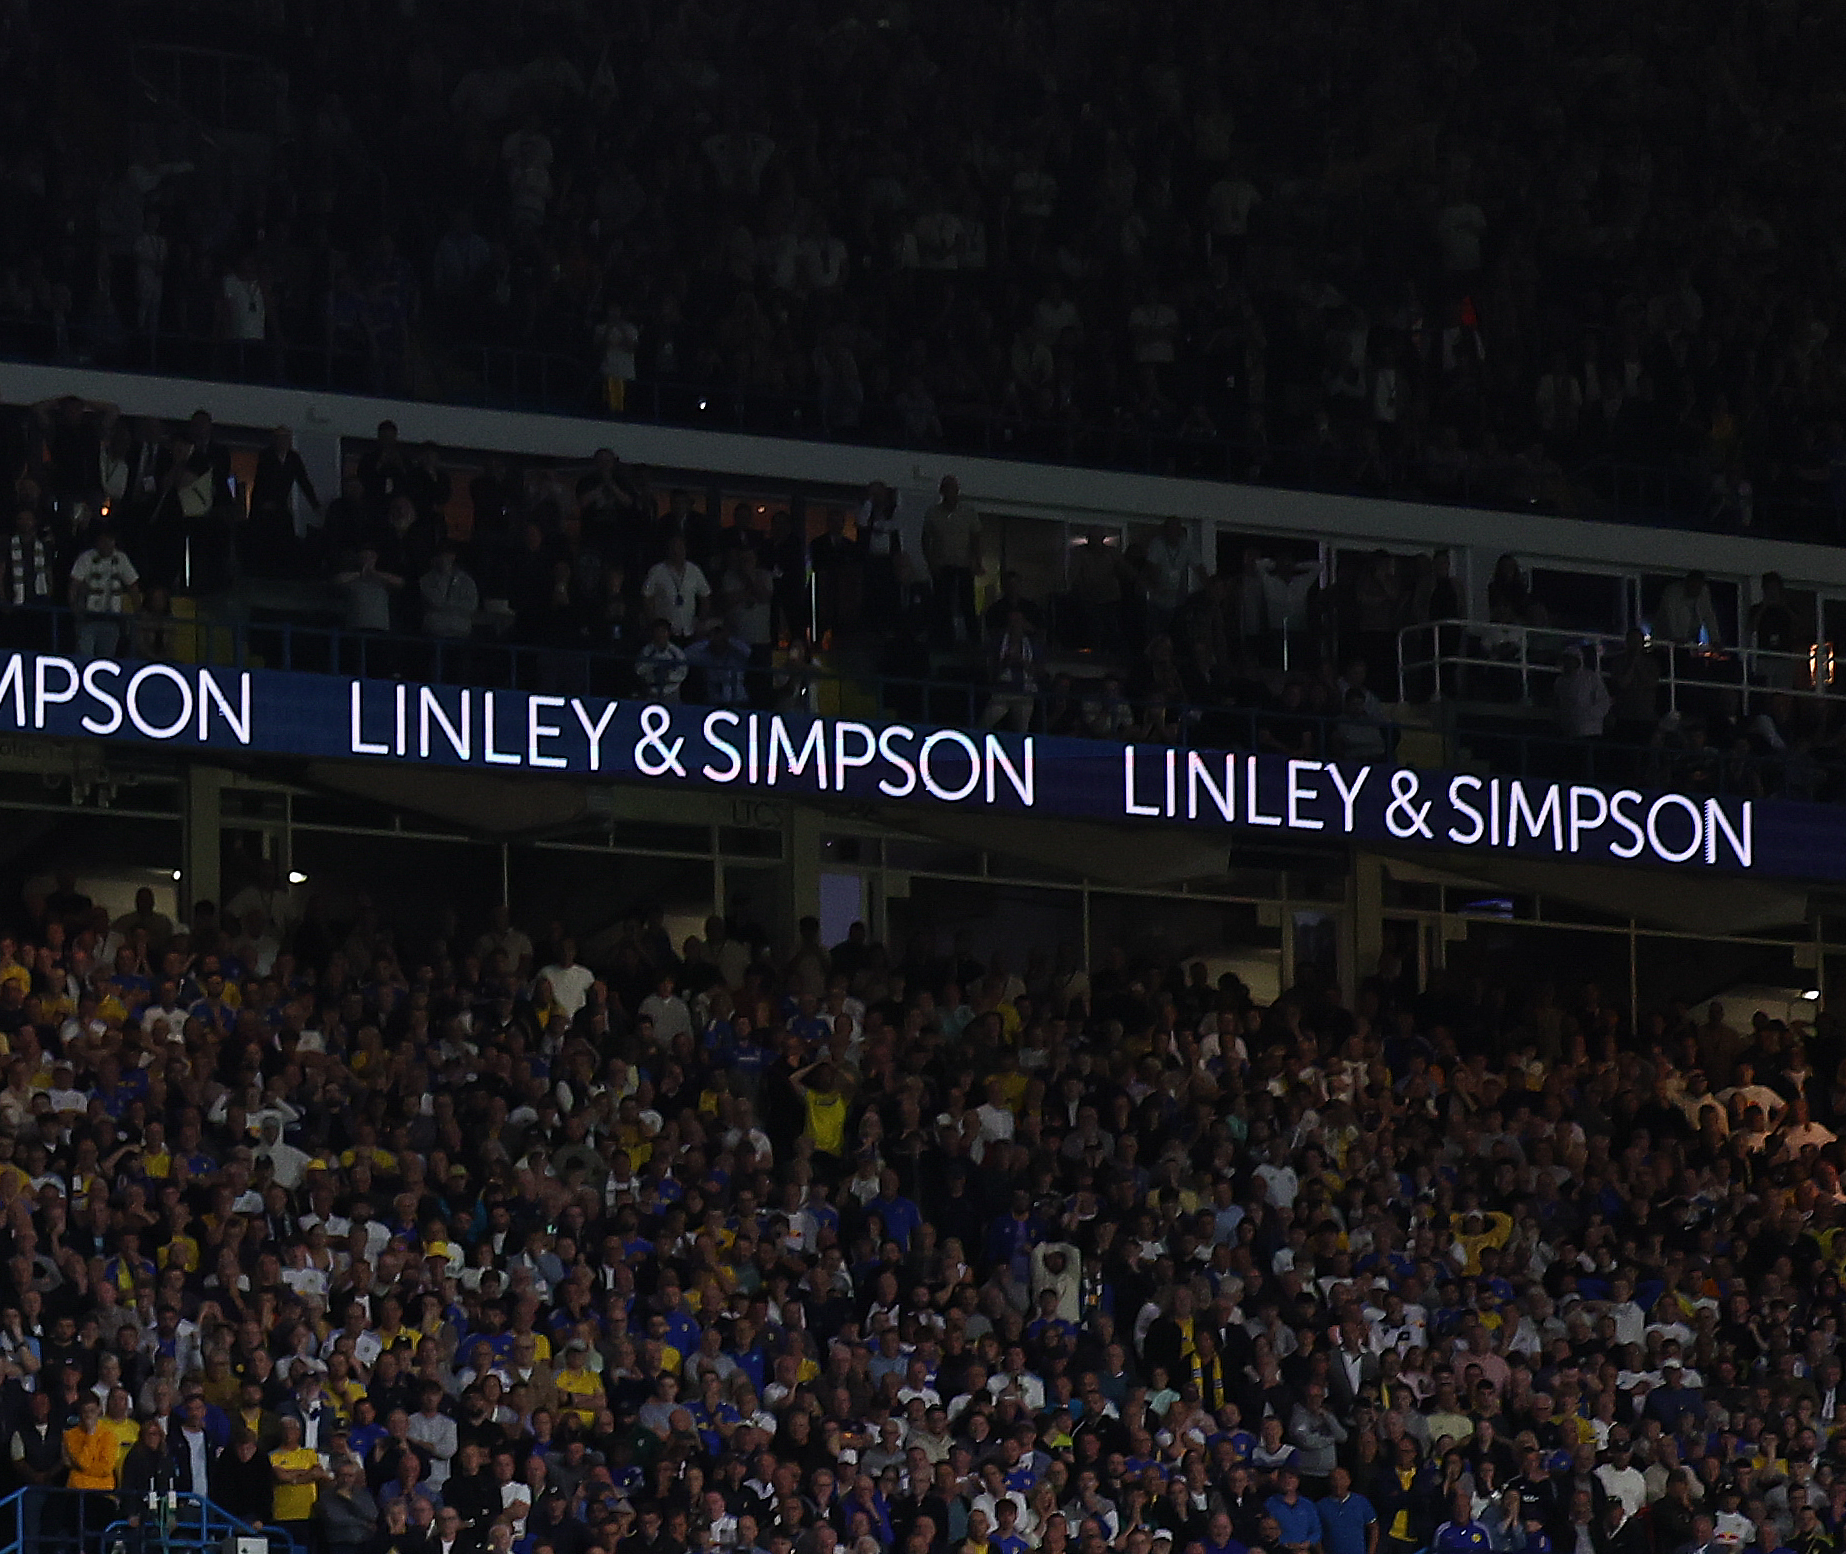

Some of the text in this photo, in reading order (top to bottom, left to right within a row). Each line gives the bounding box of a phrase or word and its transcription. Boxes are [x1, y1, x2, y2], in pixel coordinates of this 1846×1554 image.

[350, 680, 1035, 807] LINLEY & SIMPSON
[1124, 744, 1753, 868] LINLEY & SIMPSON
